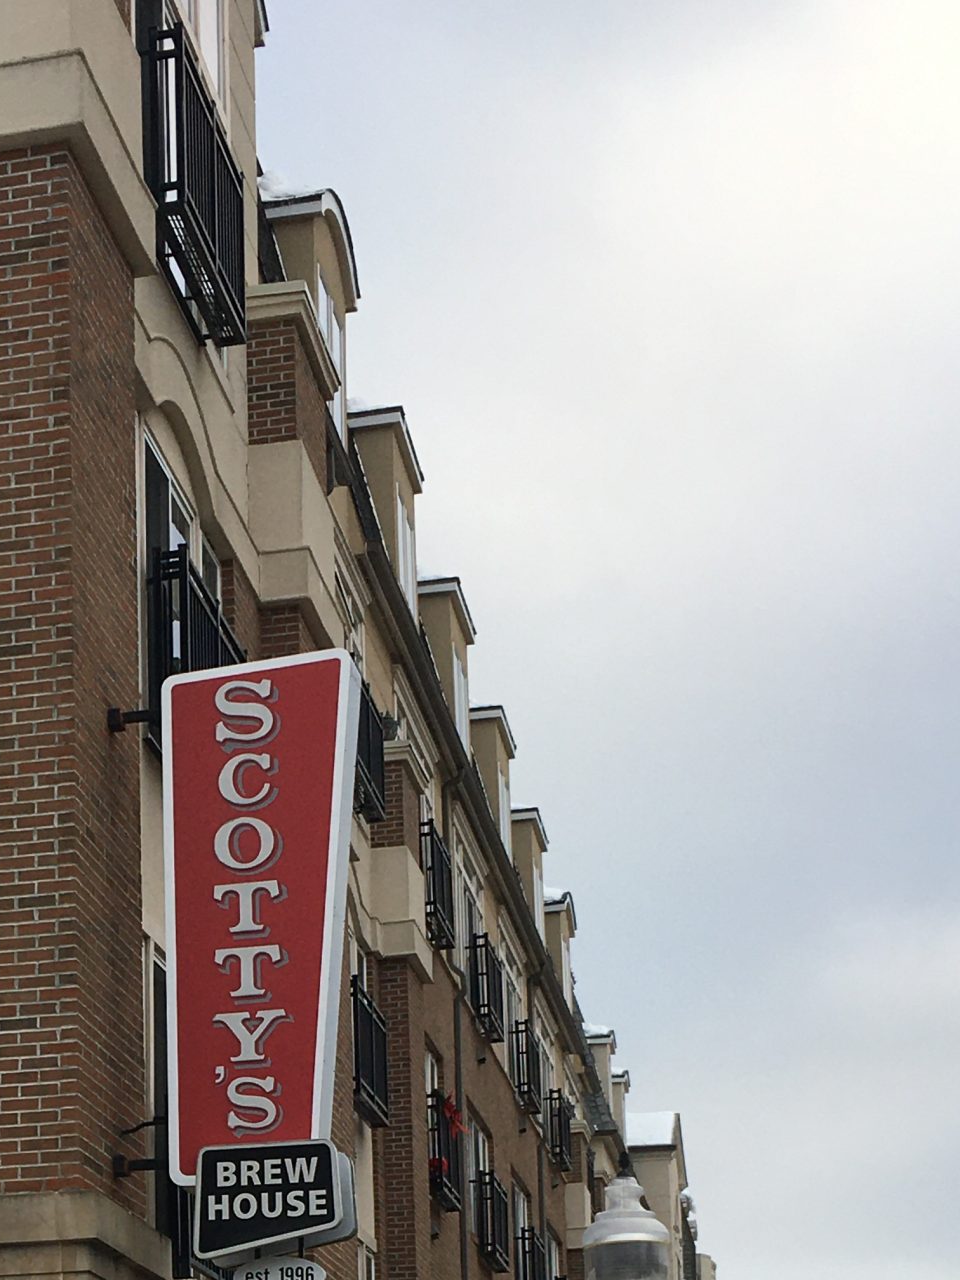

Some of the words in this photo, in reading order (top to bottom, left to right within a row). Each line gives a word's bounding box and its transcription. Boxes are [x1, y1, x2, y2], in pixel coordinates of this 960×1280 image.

[212, 678, 290, 1133] SCOTTY'S
[216, 1156, 318, 1188] BREW
[207, 1189, 328, 1221] HOUSE
